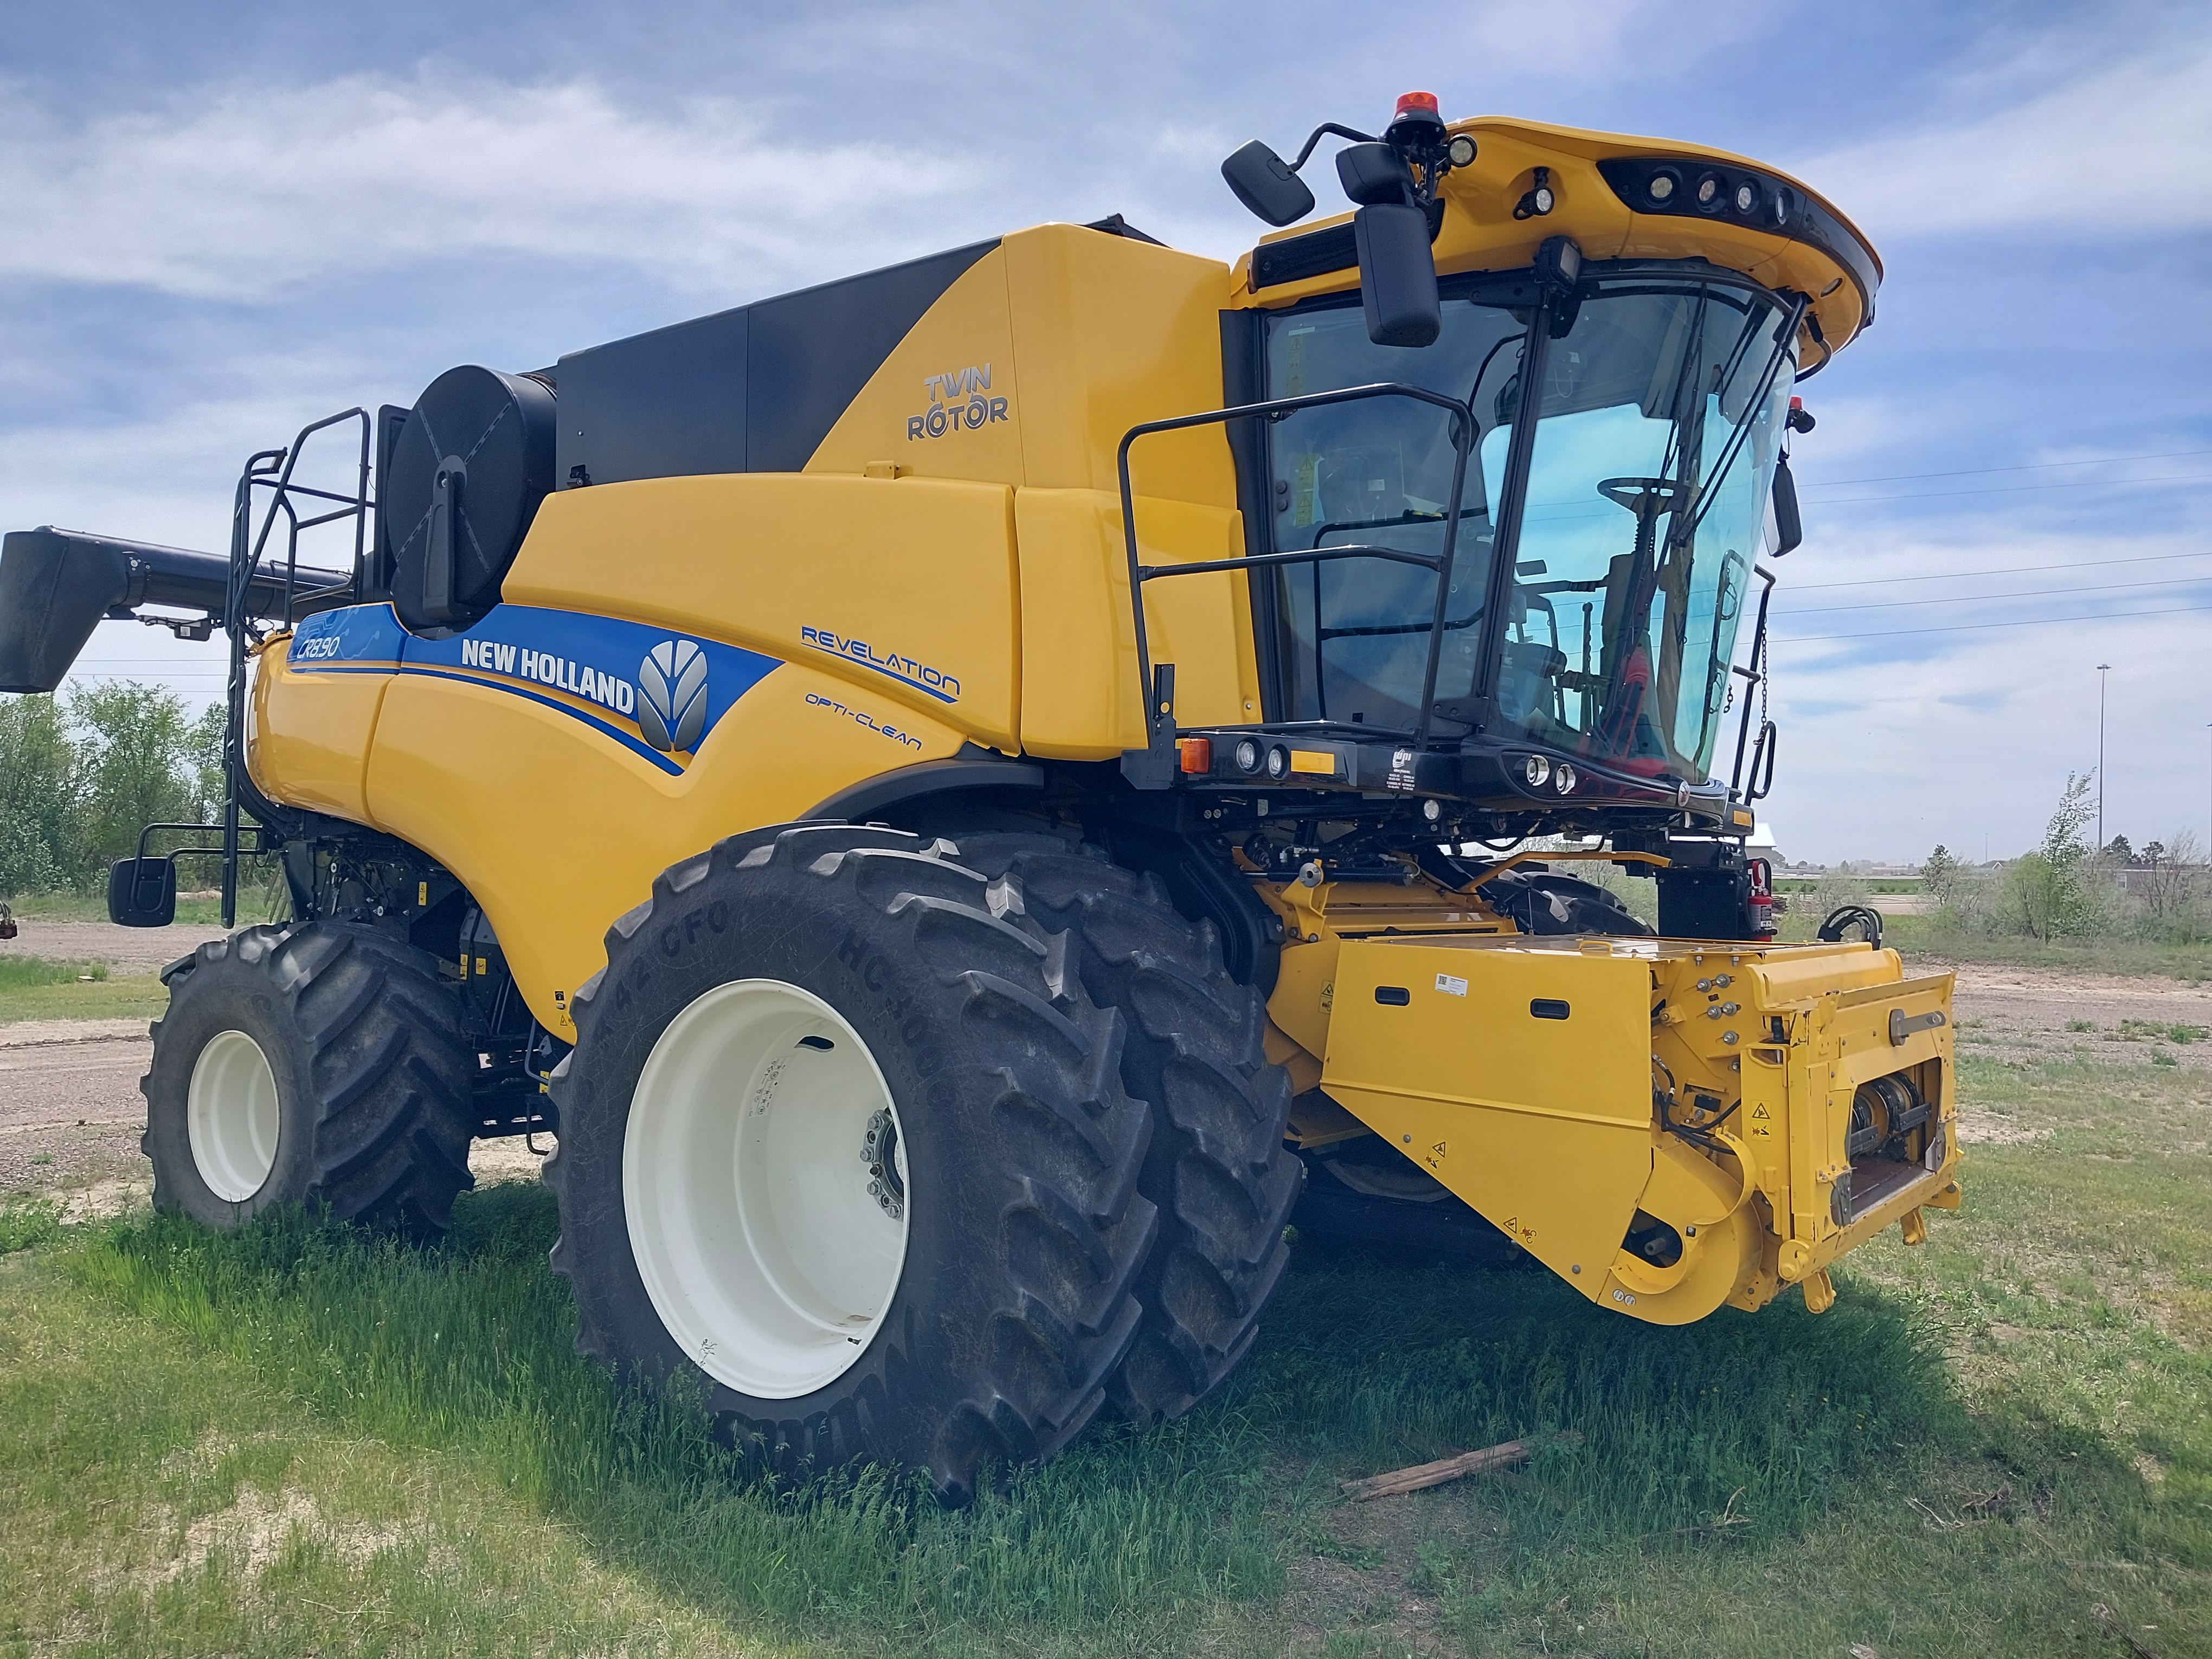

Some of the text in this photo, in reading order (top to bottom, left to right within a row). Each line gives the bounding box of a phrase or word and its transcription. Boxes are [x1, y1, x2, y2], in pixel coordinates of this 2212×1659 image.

[924, 363, 991, 402] TWIN
[908, 394, 1008, 441] ROTOR
[297, 636, 340, 659] CR8.90
[801, 626, 960, 696] REVELATION
[461, 639, 634, 715] NEW HOLLAND
[805, 693, 923, 751] OPTI-CLEAN
[659, 899, 729, 957] CFO
